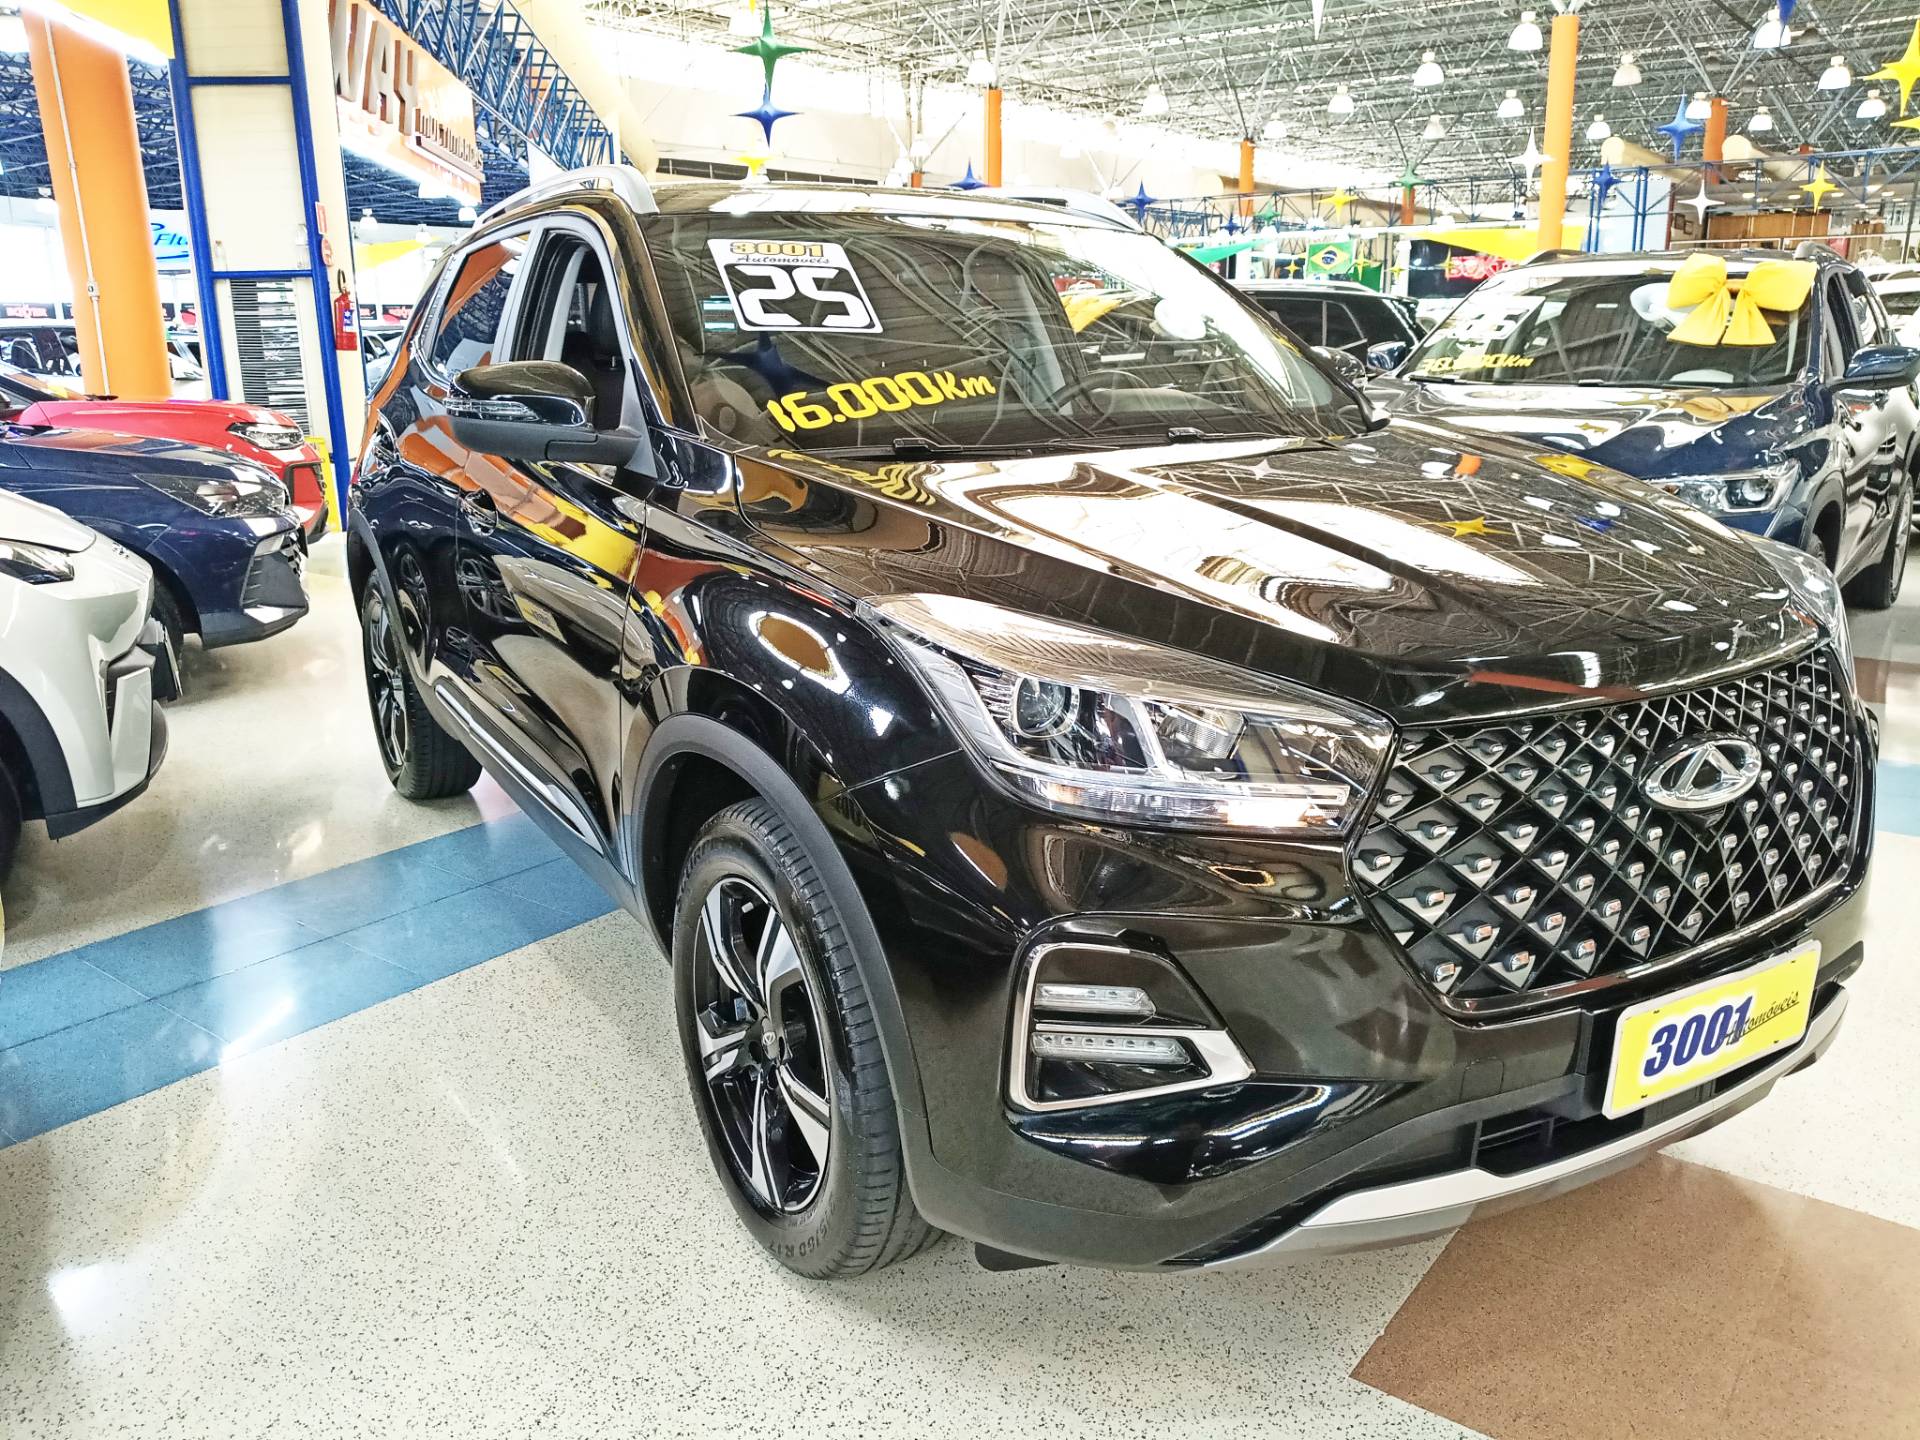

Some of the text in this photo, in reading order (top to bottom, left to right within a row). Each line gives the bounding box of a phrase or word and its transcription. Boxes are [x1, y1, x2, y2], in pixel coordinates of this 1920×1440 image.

[730, 242, 825, 258] 3001
[734, 265, 871, 328] 25
[1643, 995, 1753, 1077] 3001
